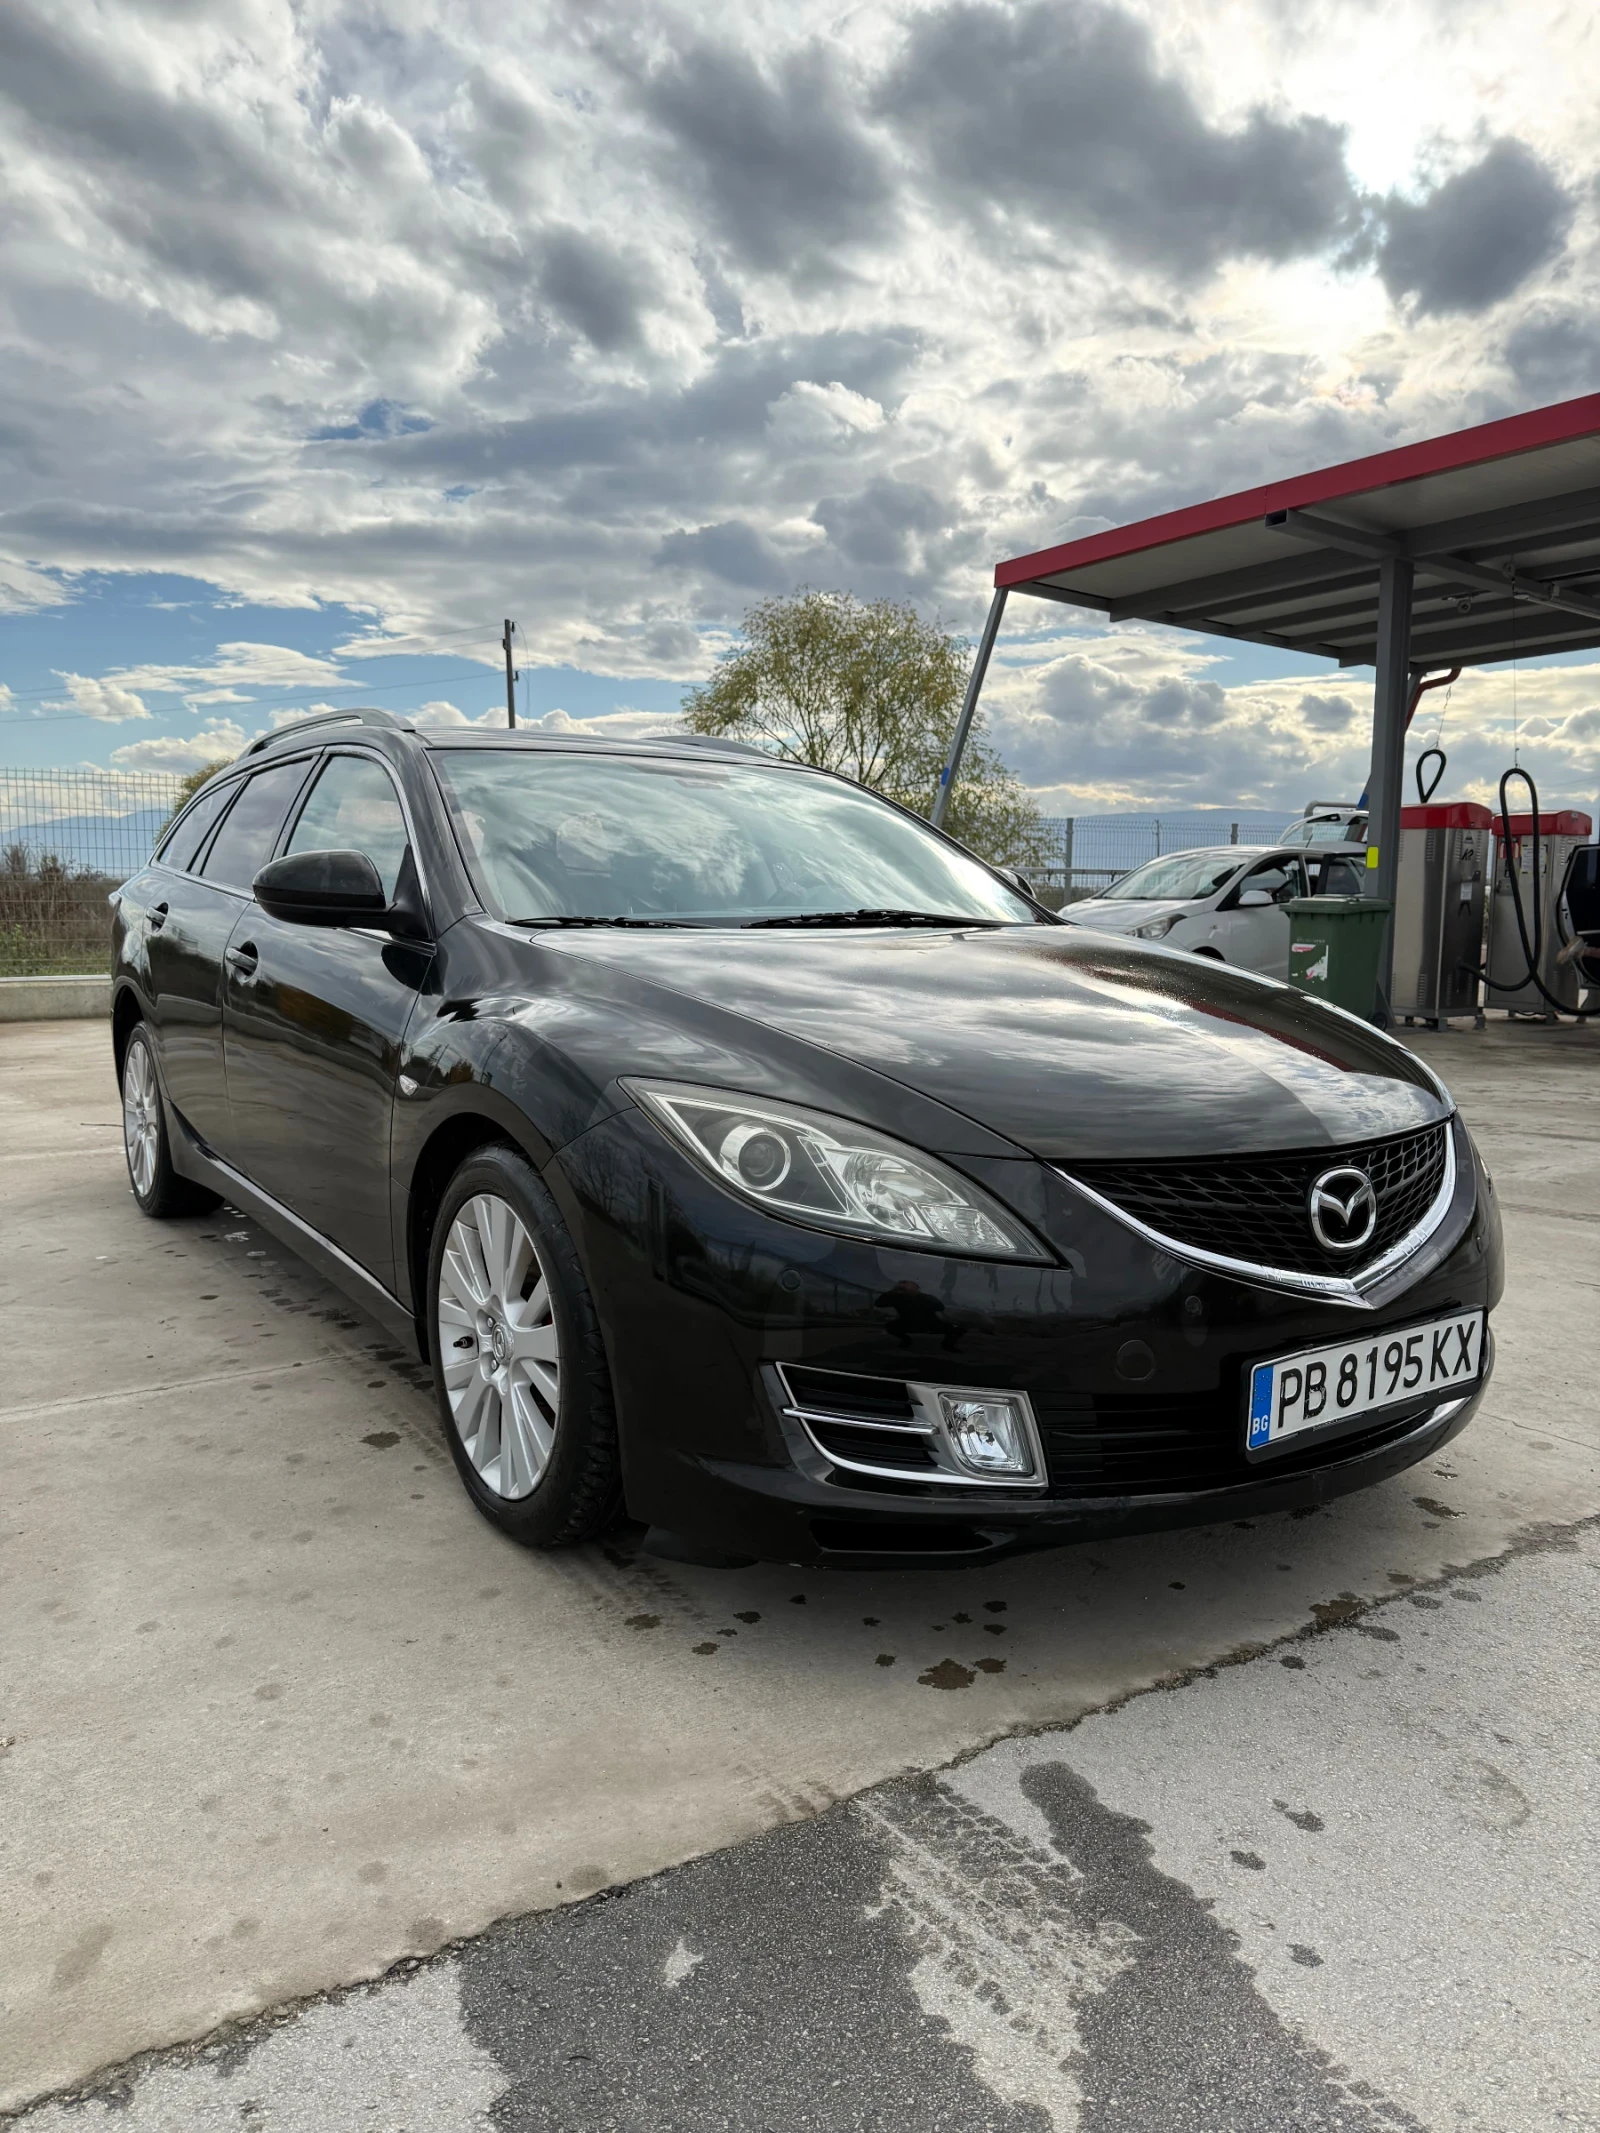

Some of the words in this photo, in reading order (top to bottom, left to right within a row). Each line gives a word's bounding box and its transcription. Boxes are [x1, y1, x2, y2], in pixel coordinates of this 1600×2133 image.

[1277, 1361, 1327, 1429] PB
[1336, 1334, 1424, 1408] 8195
[1429, 1320, 1477, 1383] KX
[1252, 1415, 1269, 1435] BG
